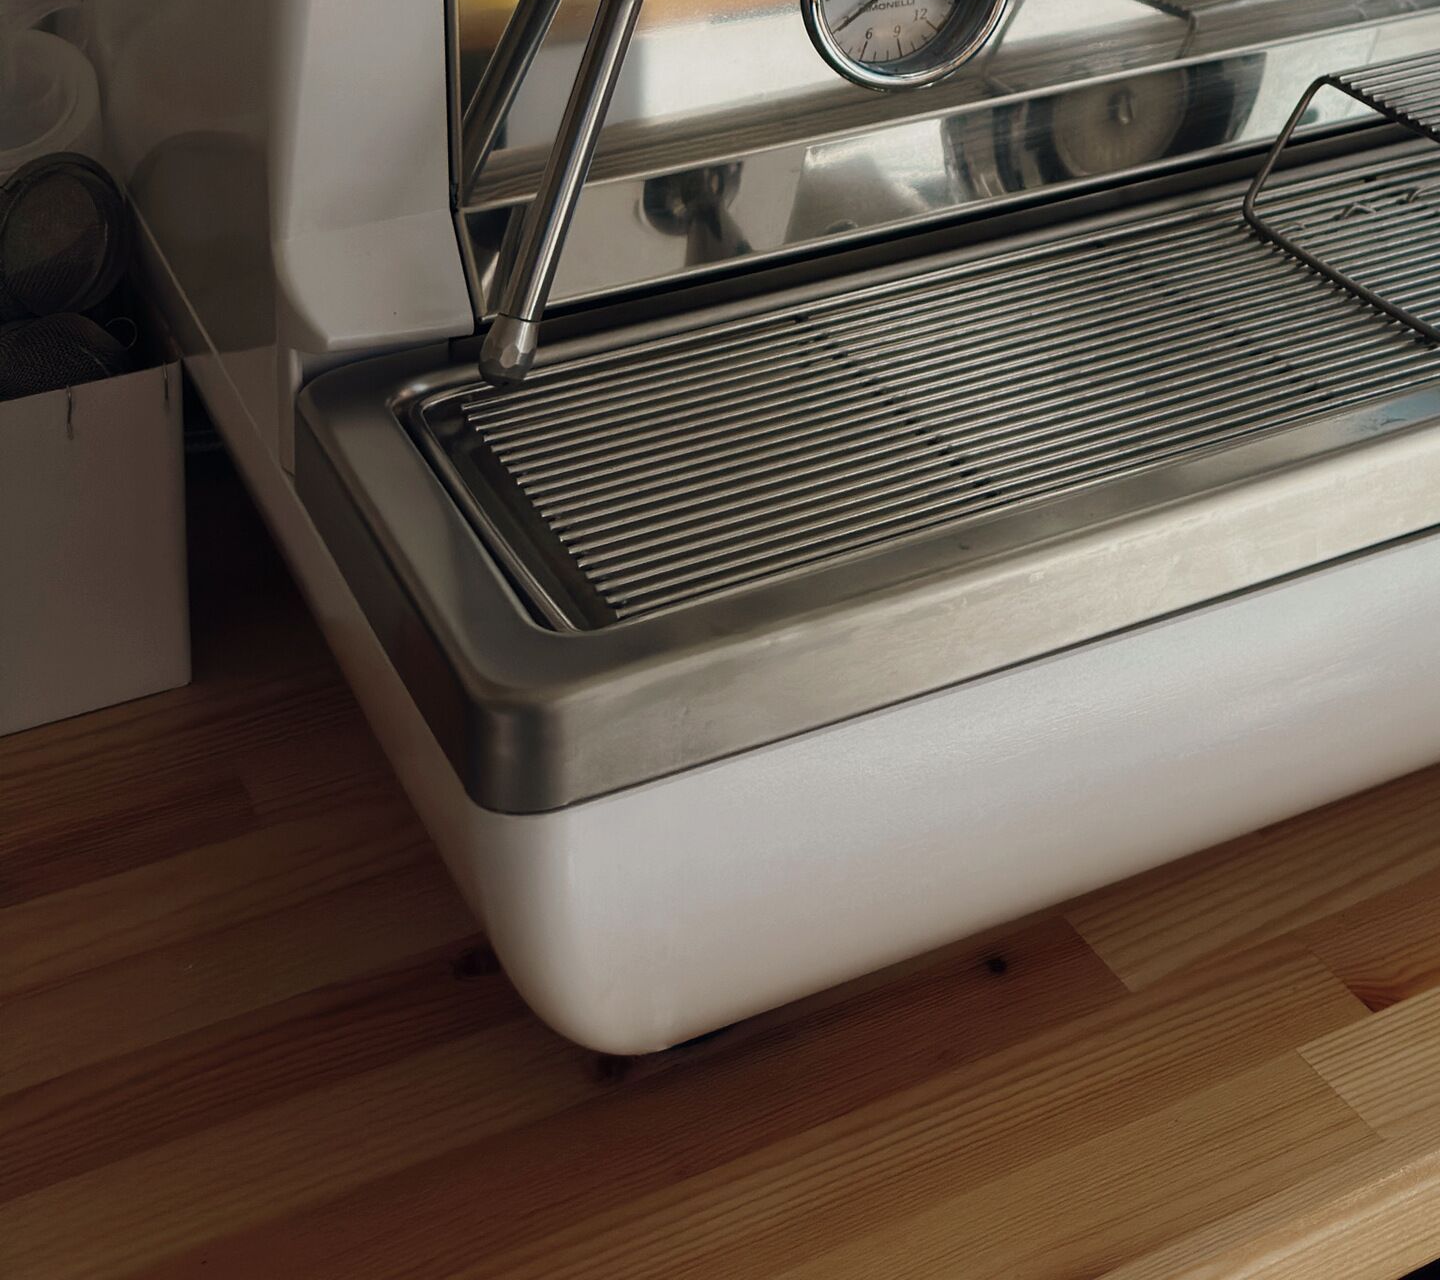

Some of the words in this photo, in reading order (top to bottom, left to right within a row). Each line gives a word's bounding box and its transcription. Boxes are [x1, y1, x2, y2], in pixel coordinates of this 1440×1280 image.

[914, 8, 928, 22] 12
[865, 26, 873, 40] 6
[893, 25, 901, 38] 9
